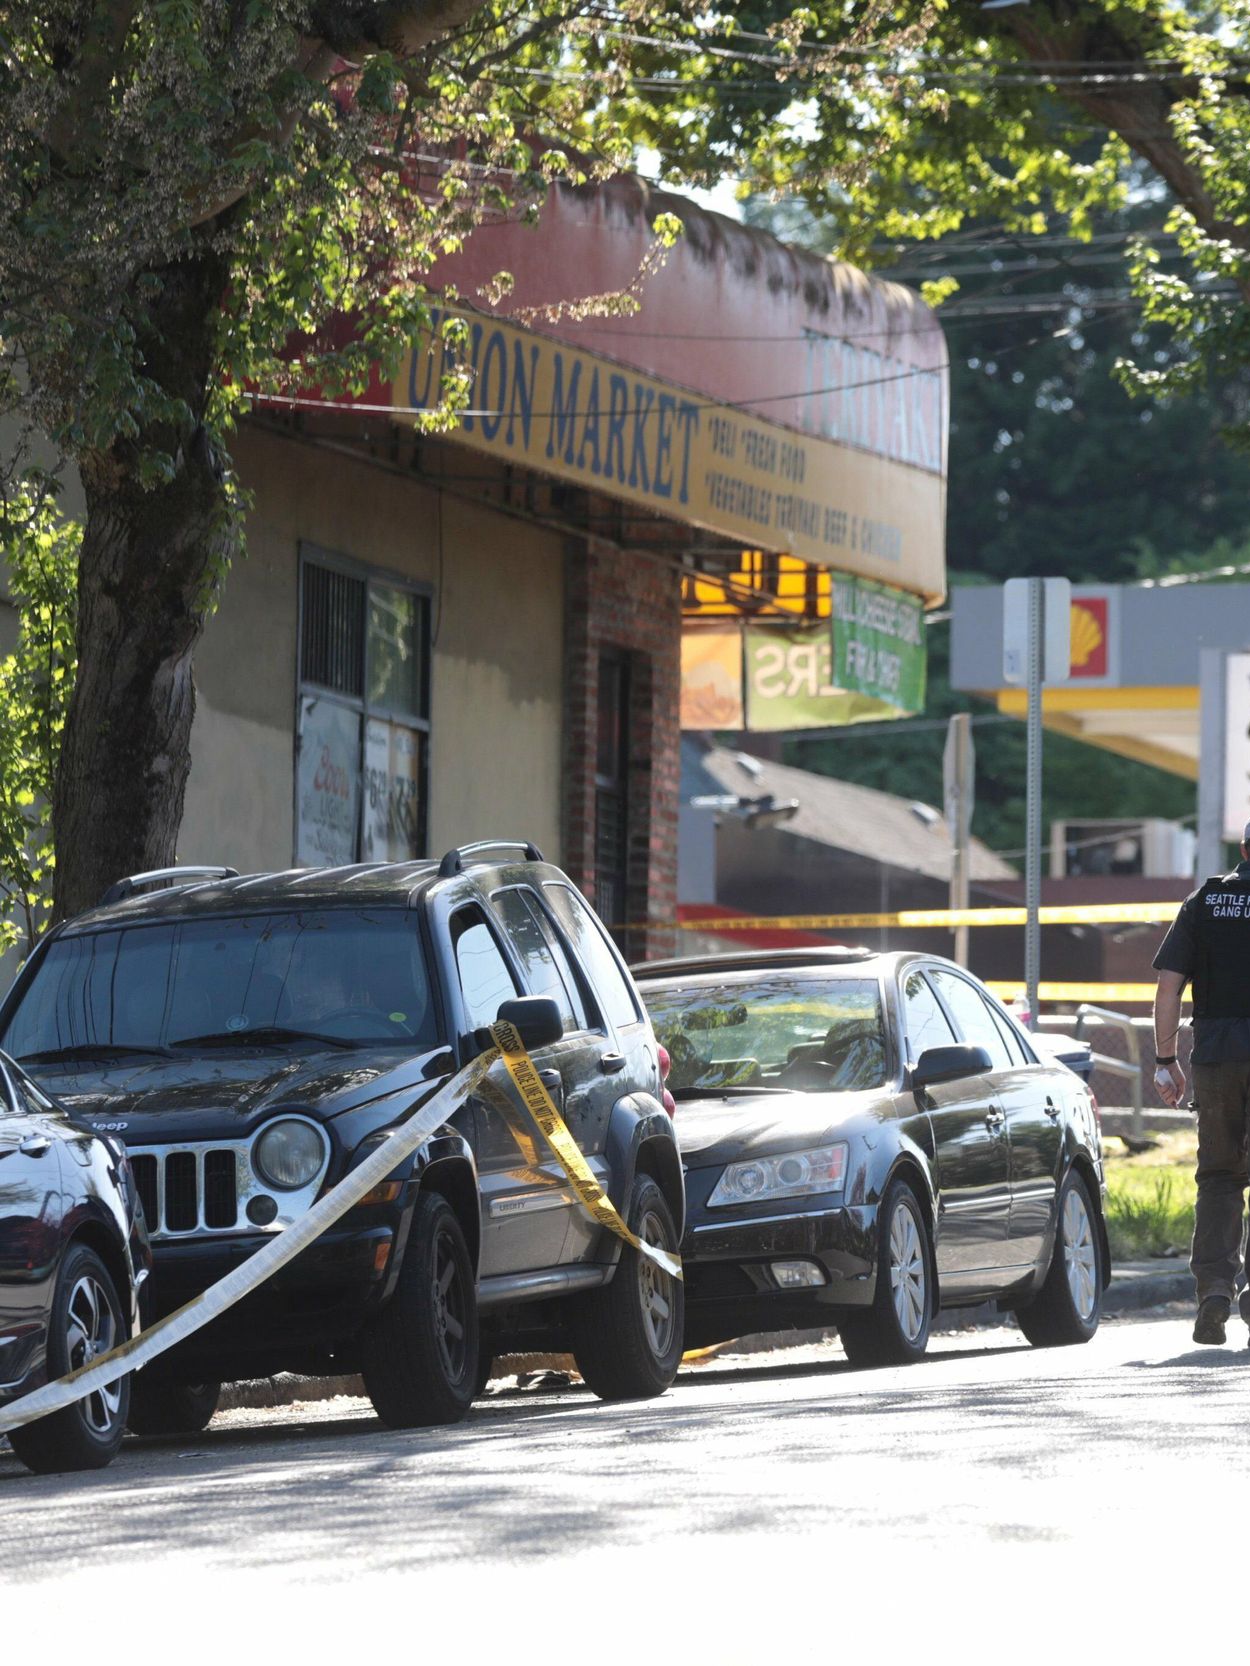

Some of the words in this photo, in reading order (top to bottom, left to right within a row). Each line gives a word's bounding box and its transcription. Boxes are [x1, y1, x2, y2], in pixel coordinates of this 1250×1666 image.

[545, 353, 699, 505] MARKET
[1205, 893, 1246, 905] SEATTLE
[1212, 906, 1241, 917] GANG
[493, 1022, 520, 1052] CROSS
[511, 1060, 536, 1086] POLICE
[522, 1082, 542, 1099] LINE
[528, 1097, 547, 1108] DO
[533, 1104, 554, 1119] NOT
